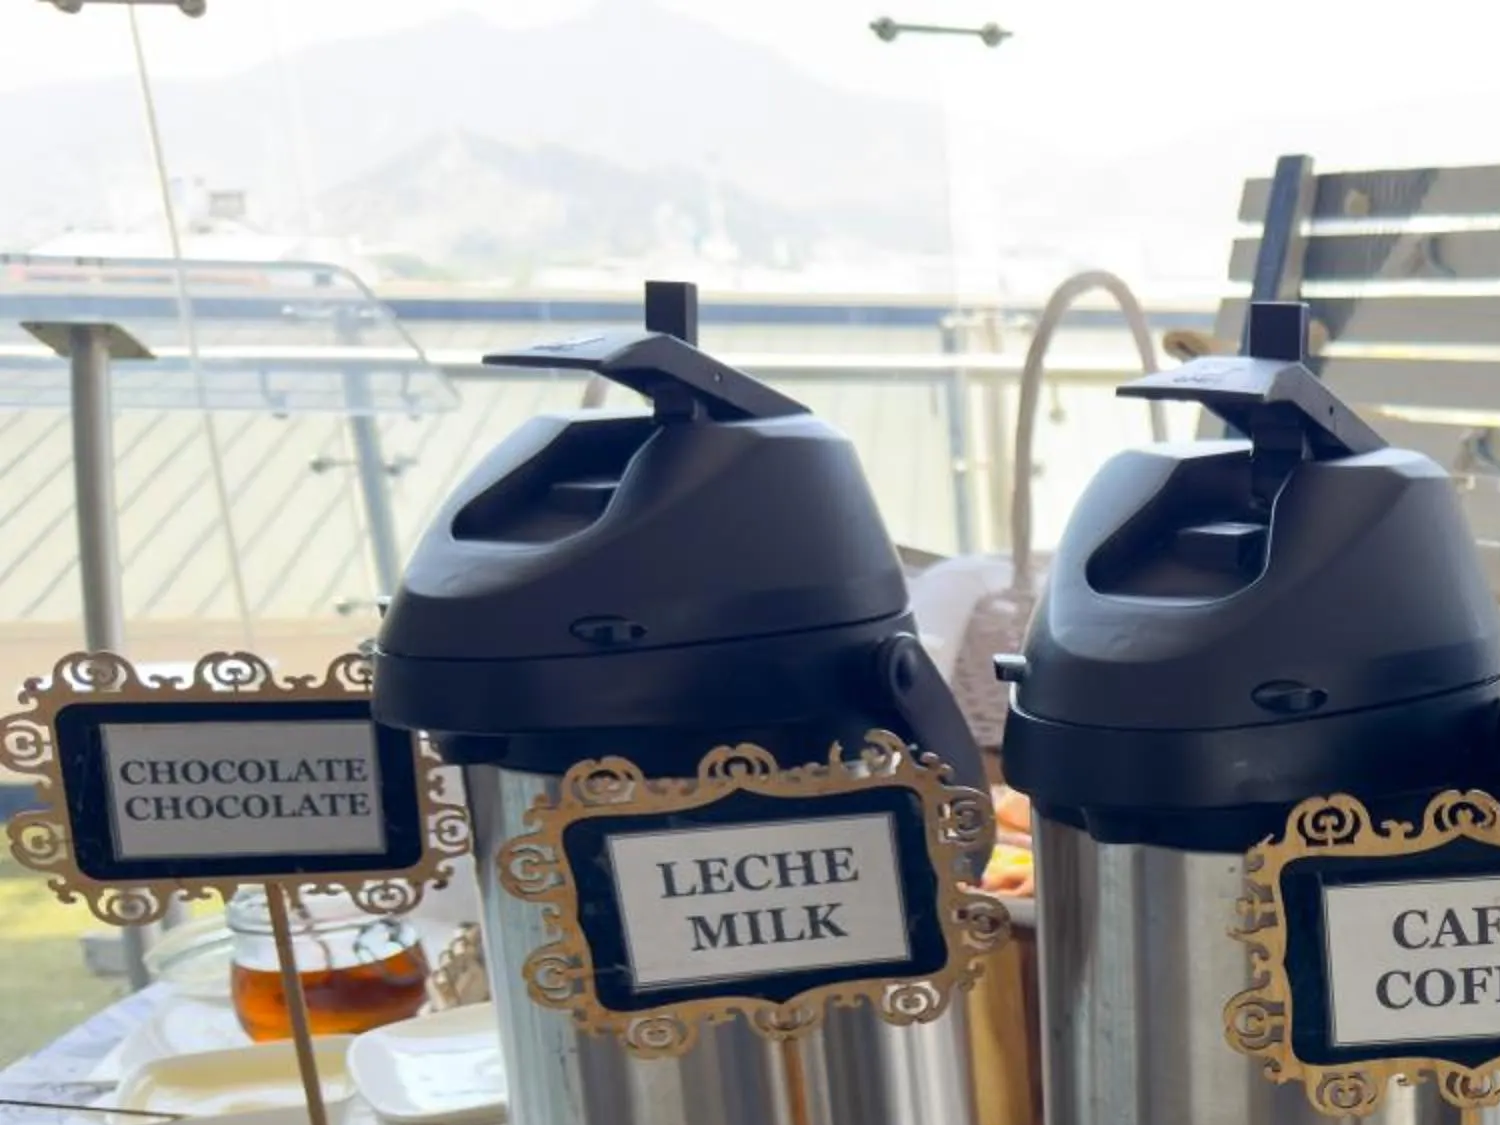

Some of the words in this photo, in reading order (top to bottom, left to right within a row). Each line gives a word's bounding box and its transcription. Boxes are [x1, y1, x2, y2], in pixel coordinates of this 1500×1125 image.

[119, 758, 369, 786] CHOCOLATE
[124, 793, 372, 821] CHOCOLATE
[655, 846, 860, 899] LECHE
[686, 902, 849, 952] MILK
